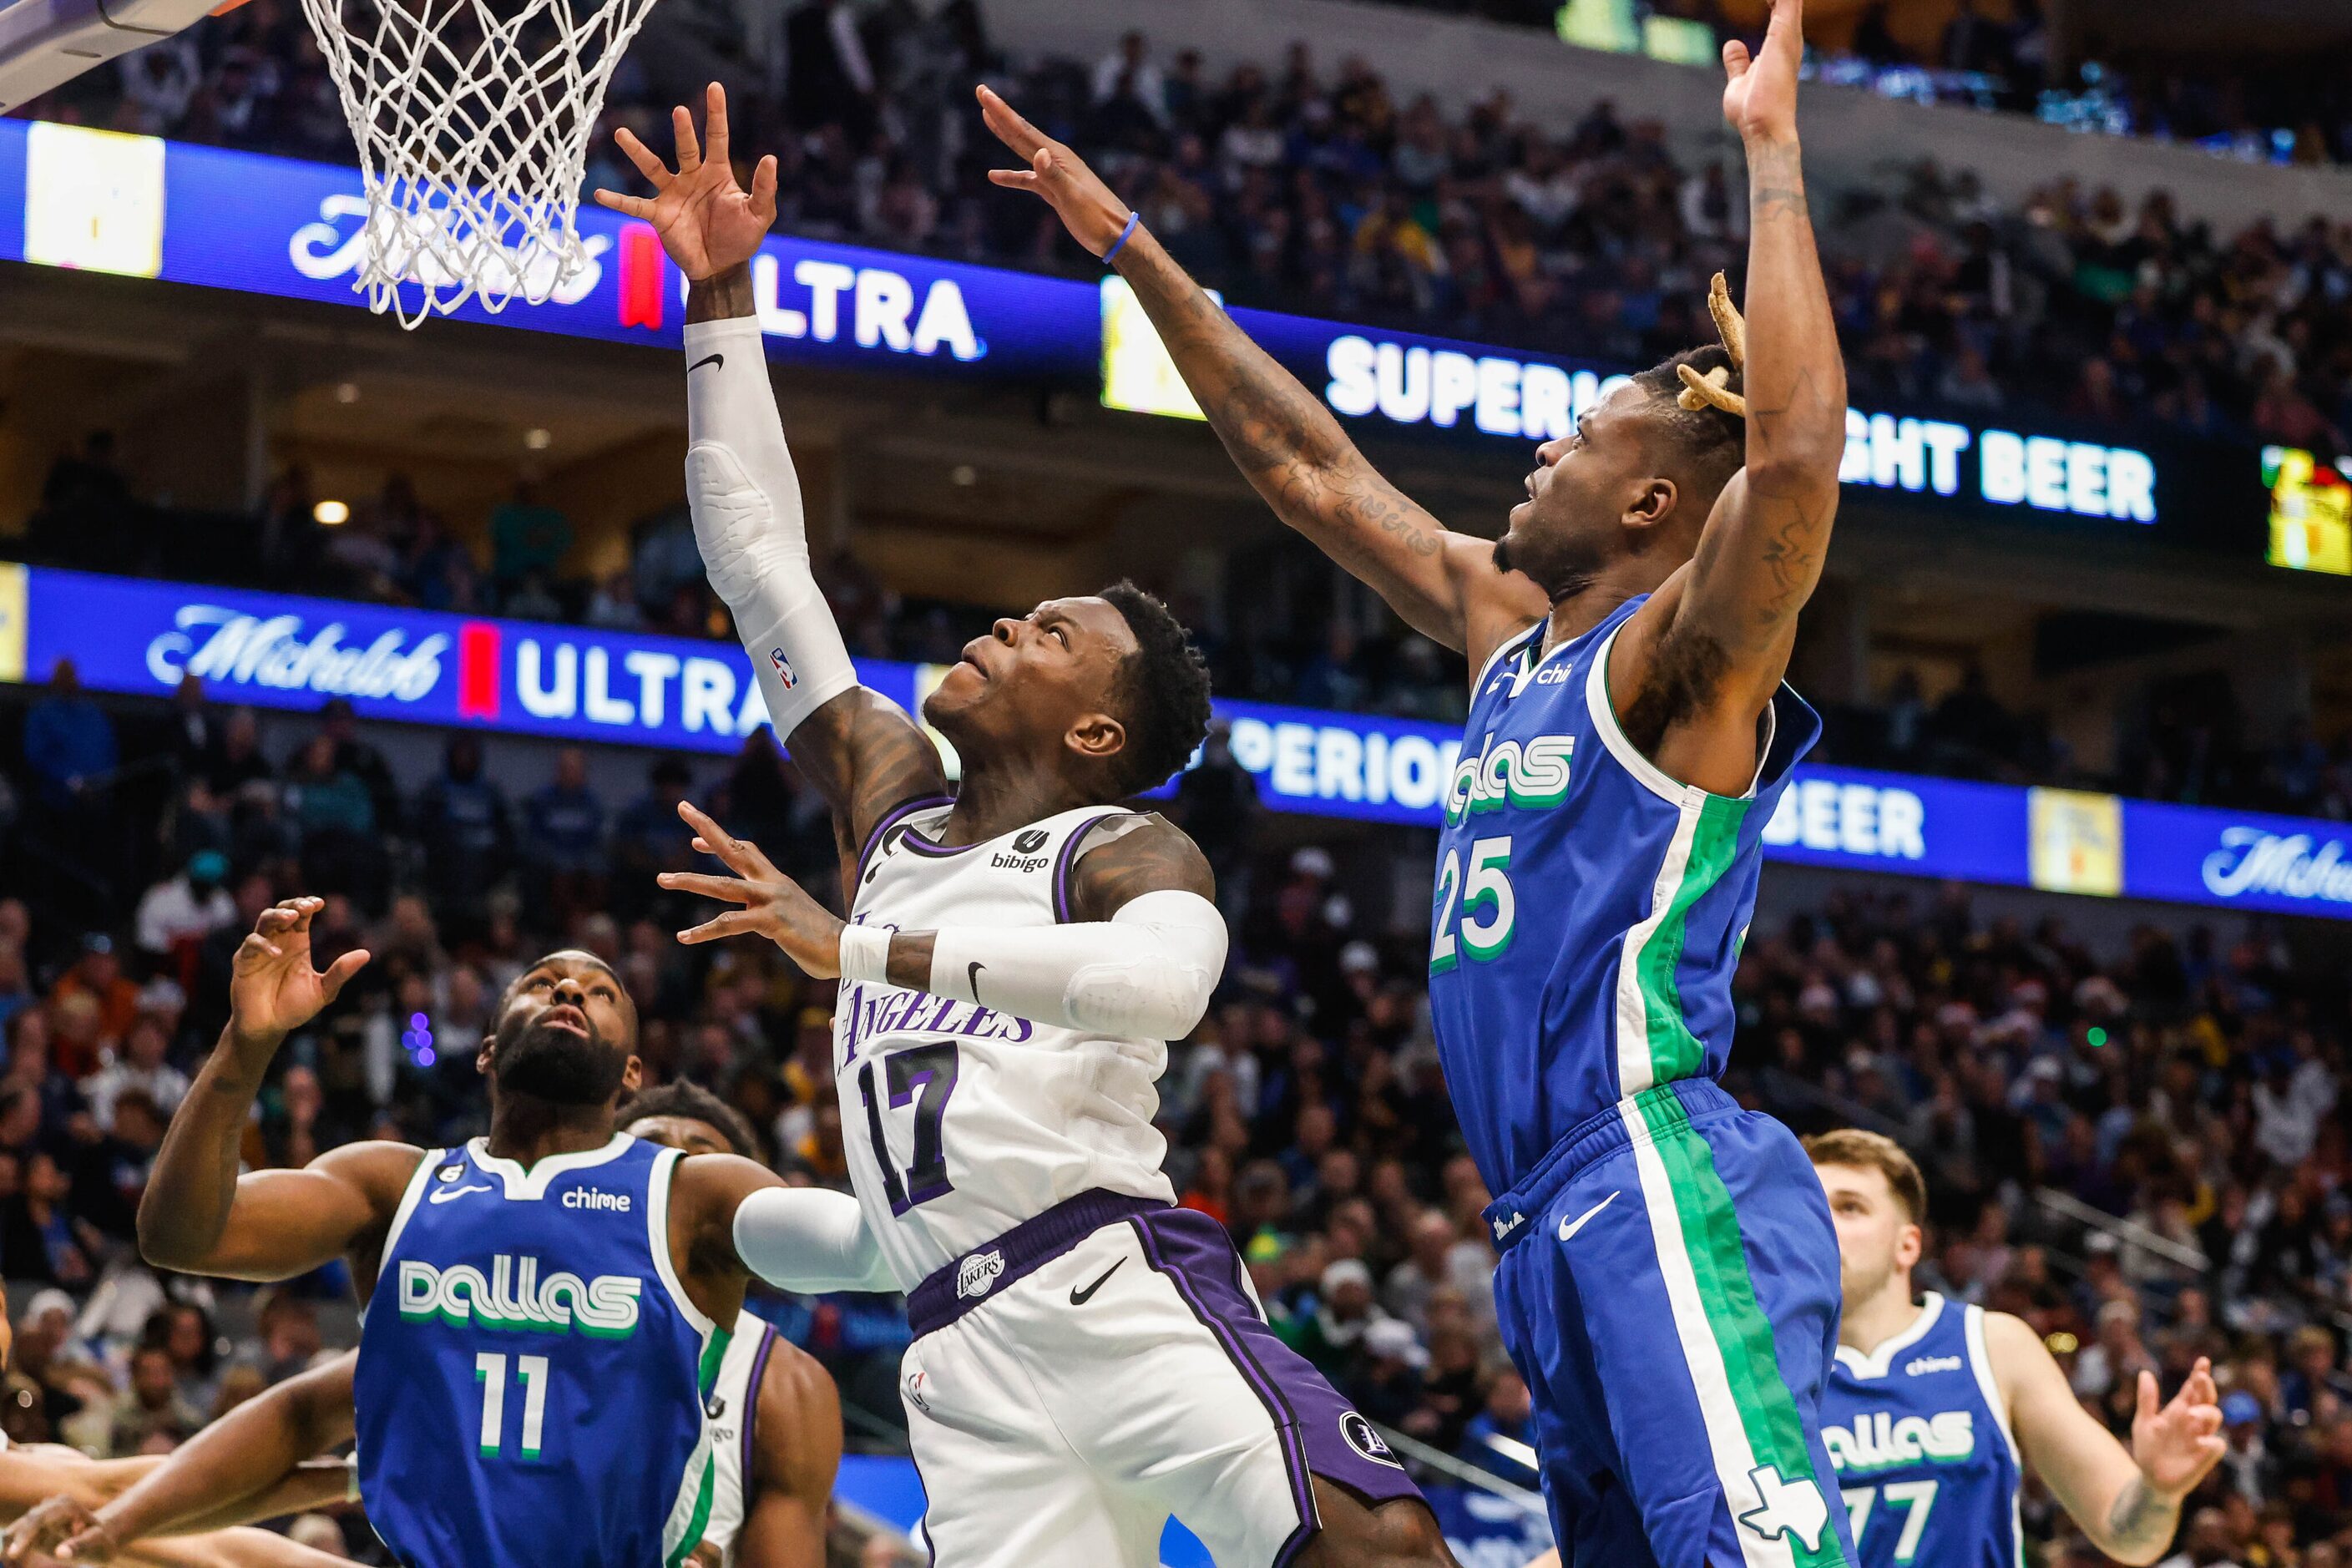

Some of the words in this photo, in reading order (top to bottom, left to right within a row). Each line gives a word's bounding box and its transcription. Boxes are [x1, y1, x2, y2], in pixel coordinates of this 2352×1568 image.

[680, 253, 985, 362] LTRA
[1980, 428, 2157, 524] BEER
[516, 639, 773, 740] ULTRA
[991, 852, 1050, 873] bibigo
[1430, 835, 1515, 978] 25
[857, 1040, 959, 1219] 17
[562, 1186, 631, 1212] chime
[398, 1254, 642, 1341] Dallas
[960, 1258, 1000, 1295] LAKERS
[475, 1352, 549, 1460] 11
